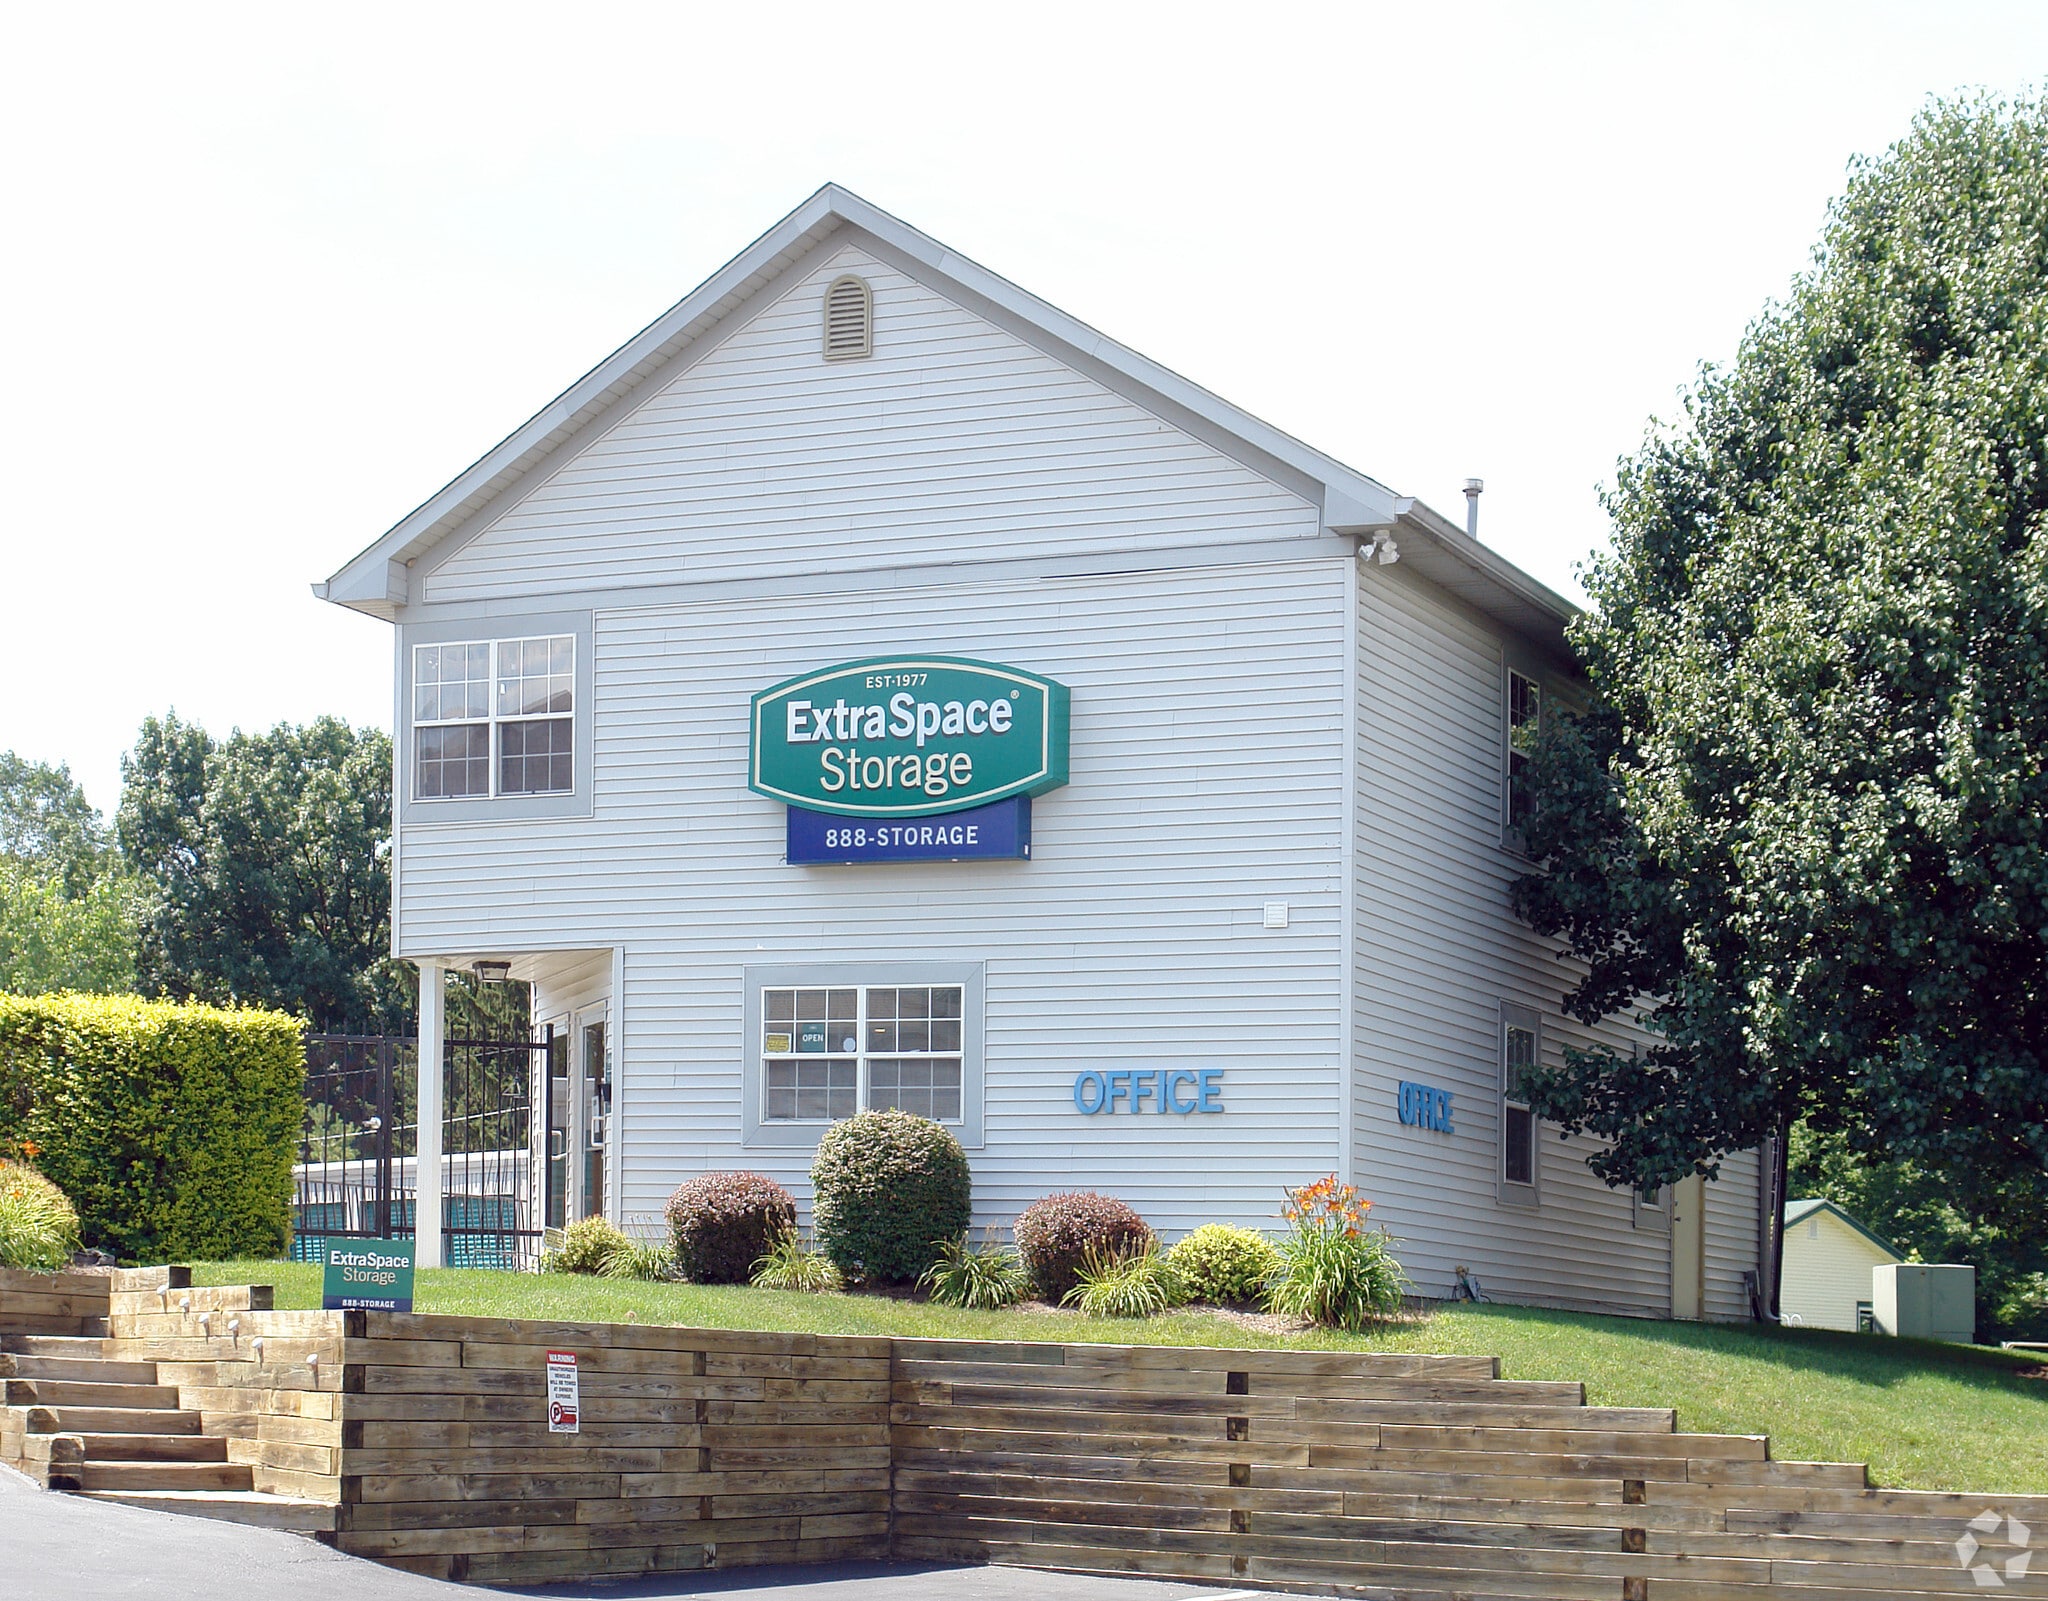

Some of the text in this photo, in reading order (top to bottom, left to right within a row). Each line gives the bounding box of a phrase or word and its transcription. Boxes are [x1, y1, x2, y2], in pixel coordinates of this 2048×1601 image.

[820, 747, 973, 796] Storage
[825, 825, 979, 848] 888-STORAGE
[802, 1033, 824, 1042] OPEN
[1073, 1068, 1225, 1116] OFFICE
[342, 1299, 396, 1309] 888-STORAGE
